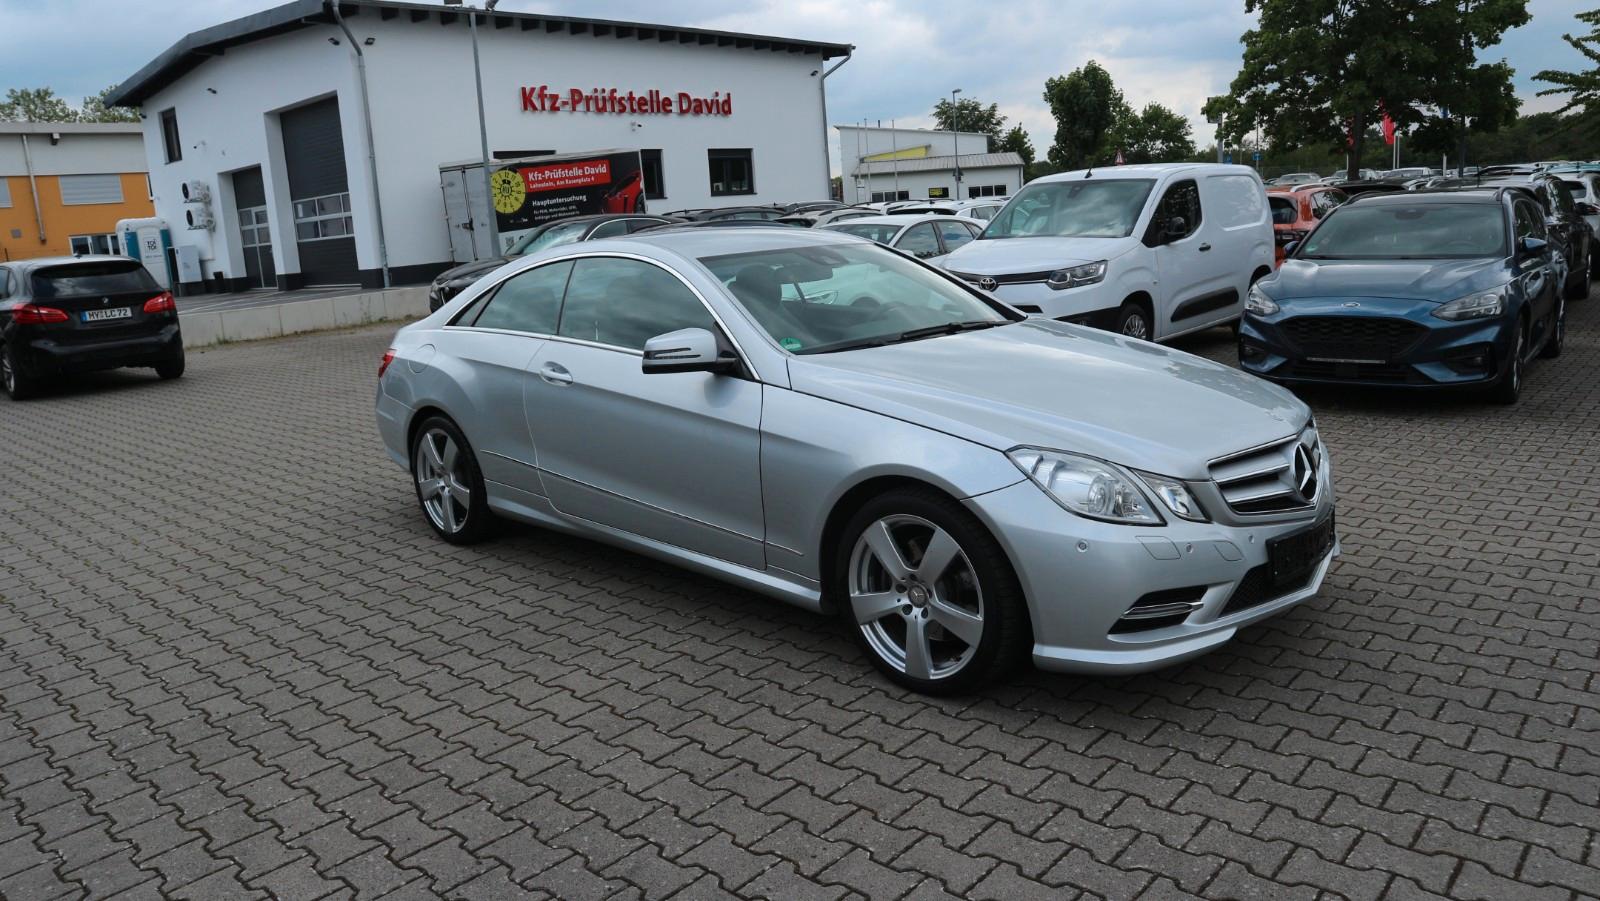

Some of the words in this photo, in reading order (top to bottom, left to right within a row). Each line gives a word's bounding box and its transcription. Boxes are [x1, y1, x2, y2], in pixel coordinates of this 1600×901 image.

[521, 85, 673, 113] Kfz-Prüfstelle
[678, 91, 732, 115] David
[528, 166, 583, 182] Kfz-Prüfstelle
[584, 164, 607, 175] David
[532, 195, 587, 207] Hauptuntersuchung
[117, 308, 128, 317] 72
